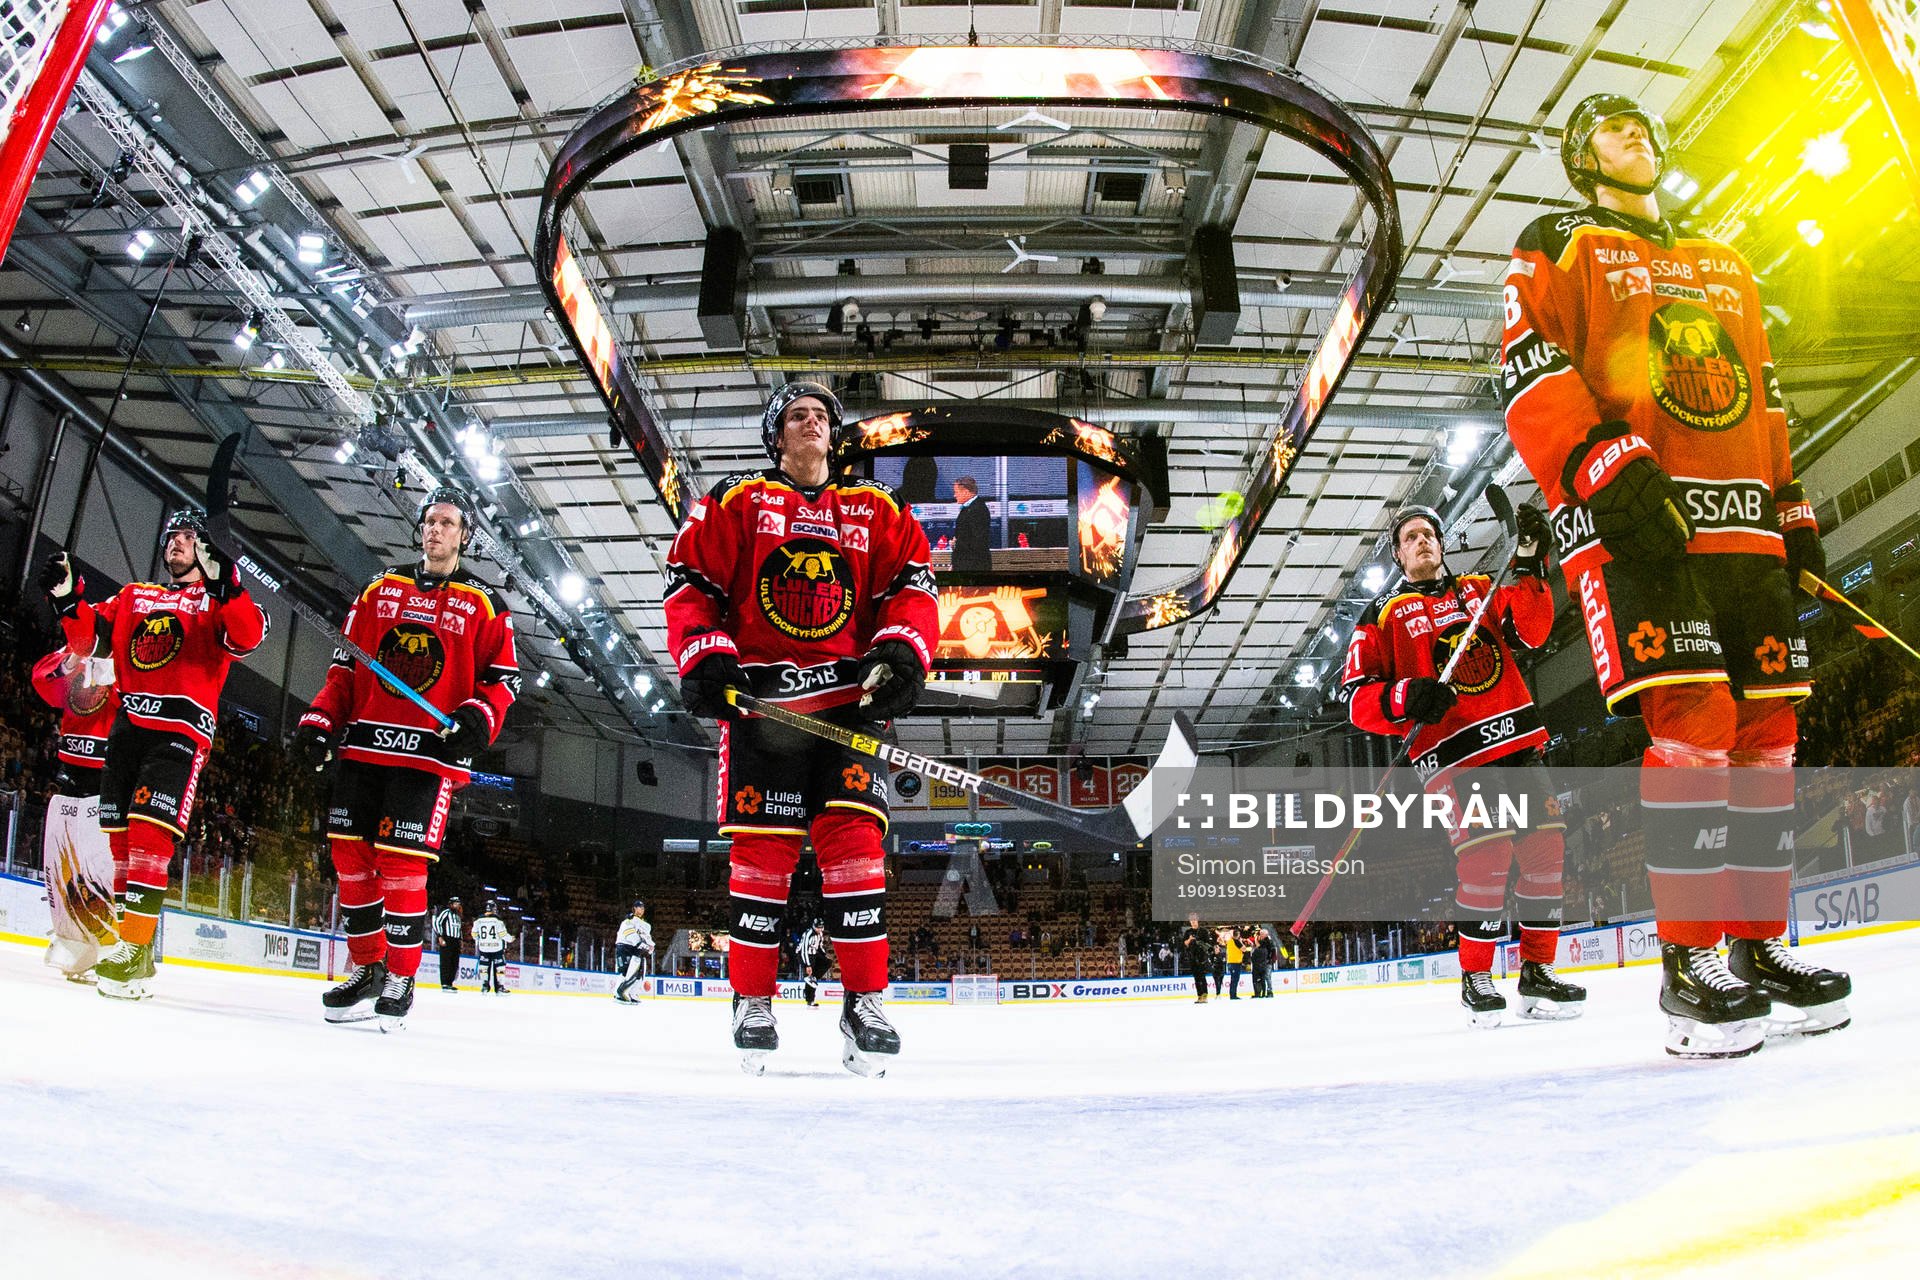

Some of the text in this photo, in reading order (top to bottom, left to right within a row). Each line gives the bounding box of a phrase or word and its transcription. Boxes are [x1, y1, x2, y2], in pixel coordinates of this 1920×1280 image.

[1554, 213, 1598, 237] SSAB
[1607, 249, 1639, 263] LKAB
[1651, 259, 1694, 280] SSAB
[1712, 260, 1741, 276] LKA
[1654, 284, 1706, 300] SCANIA
[1515, 341, 1561, 377] LKA
[1661, 392, 1748, 428] HOCKEYFÖRENING
[1588, 434, 1652, 486] BAU
[855, 478, 894, 494] SSAB
[796, 506, 834, 522] SSAB
[1684, 489, 1762, 522] SSAB
[758, 513, 782, 533] AX
[792, 523, 837, 538] SCANIA
[841, 527, 868, 549] MAX
[237, 554, 282, 593] BAUER
[379, 586, 403, 598] LKAB
[465, 578, 493, 595] SSAB
[773, 575, 843, 600] LULEÅ
[199, 592, 210, 612] A
[406, 596, 437, 610] SSAB
[454, 598, 477, 615] LKAB
[1375, 588, 1400, 608] SSAB
[1432, 599, 1459, 614] SSAB
[760, 577, 853, 638] LULEÅ HOCKEYFÖRENING 1977
[773, 592, 841, 626] HOCKEY
[1402, 600, 1424, 615] LKAB
[402, 611, 435, 622] SCANIA
[441, 611, 464, 633] MAX
[1406, 618, 1432, 637] MAX
[1670, 619, 1711, 637] Luleå
[123, 694, 163, 714] SSAB
[299, 713, 331, 728] UER
[372, 728, 421, 751] SSAB
[1480, 717, 1516, 745] SSAB
[66, 737, 96, 755] SSAB
[856, 738, 873, 749] 25
[889, 748, 985, 793] BAUER
[933, 785, 966, 799] 1996
[1025, 774, 1052, 795] 35
[1081, 778, 1096, 794] 4
[152, 790, 177, 807] Luleå
[765, 789, 803, 804] Luleå
[60, 803, 79, 817] SSAB
[150, 798, 178, 817] Energi
[396, 819, 424, 831] Luleå
[1693, 825, 1728, 851] NE
[1814, 882, 1880, 931] SSAB
[739, 912, 781, 933] NEX
[842, 906, 882, 927] NEX
[385, 924, 411, 936] NEX
[480, 925, 497, 940] 64
[263, 932, 289, 959] JWAB
[1582, 937, 1600, 949] Luleå
[1582, 949, 1604, 961] Energi
[1301, 970, 1341, 985] SUBWAY
[664, 981, 693, 994] MABI
[1013, 984, 1068, 999] BDX
[1072, 985, 1128, 996] Granec
